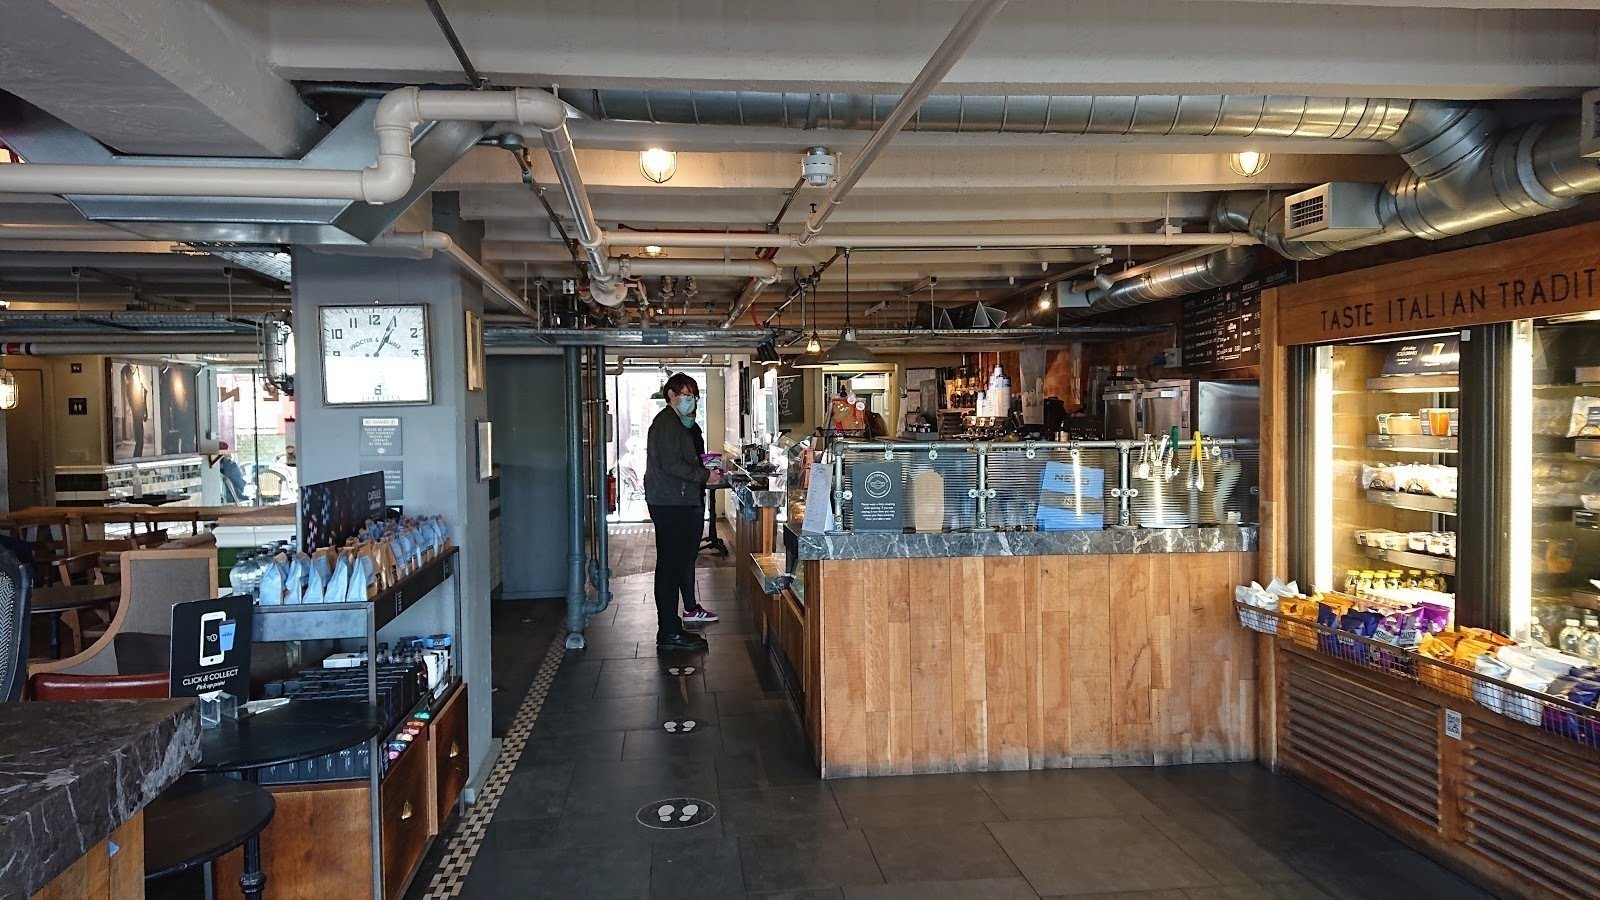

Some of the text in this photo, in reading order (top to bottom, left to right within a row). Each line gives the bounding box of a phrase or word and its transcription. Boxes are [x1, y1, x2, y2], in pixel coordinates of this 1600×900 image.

[1320, 268, 1597, 332] TASTE ITALIAN TRADIT
[349, 317, 358, 329] 11
[368, 314, 381, 326] 12
[331, 328, 343, 340] 10
[409, 327, 418, 339] 2
[349, 337, 374, 351] PROCTER
[1054, 474, 1090, 485] NEO
[182, 676, 203, 686] CLICK
[209, 668, 239, 681] COLLECT
